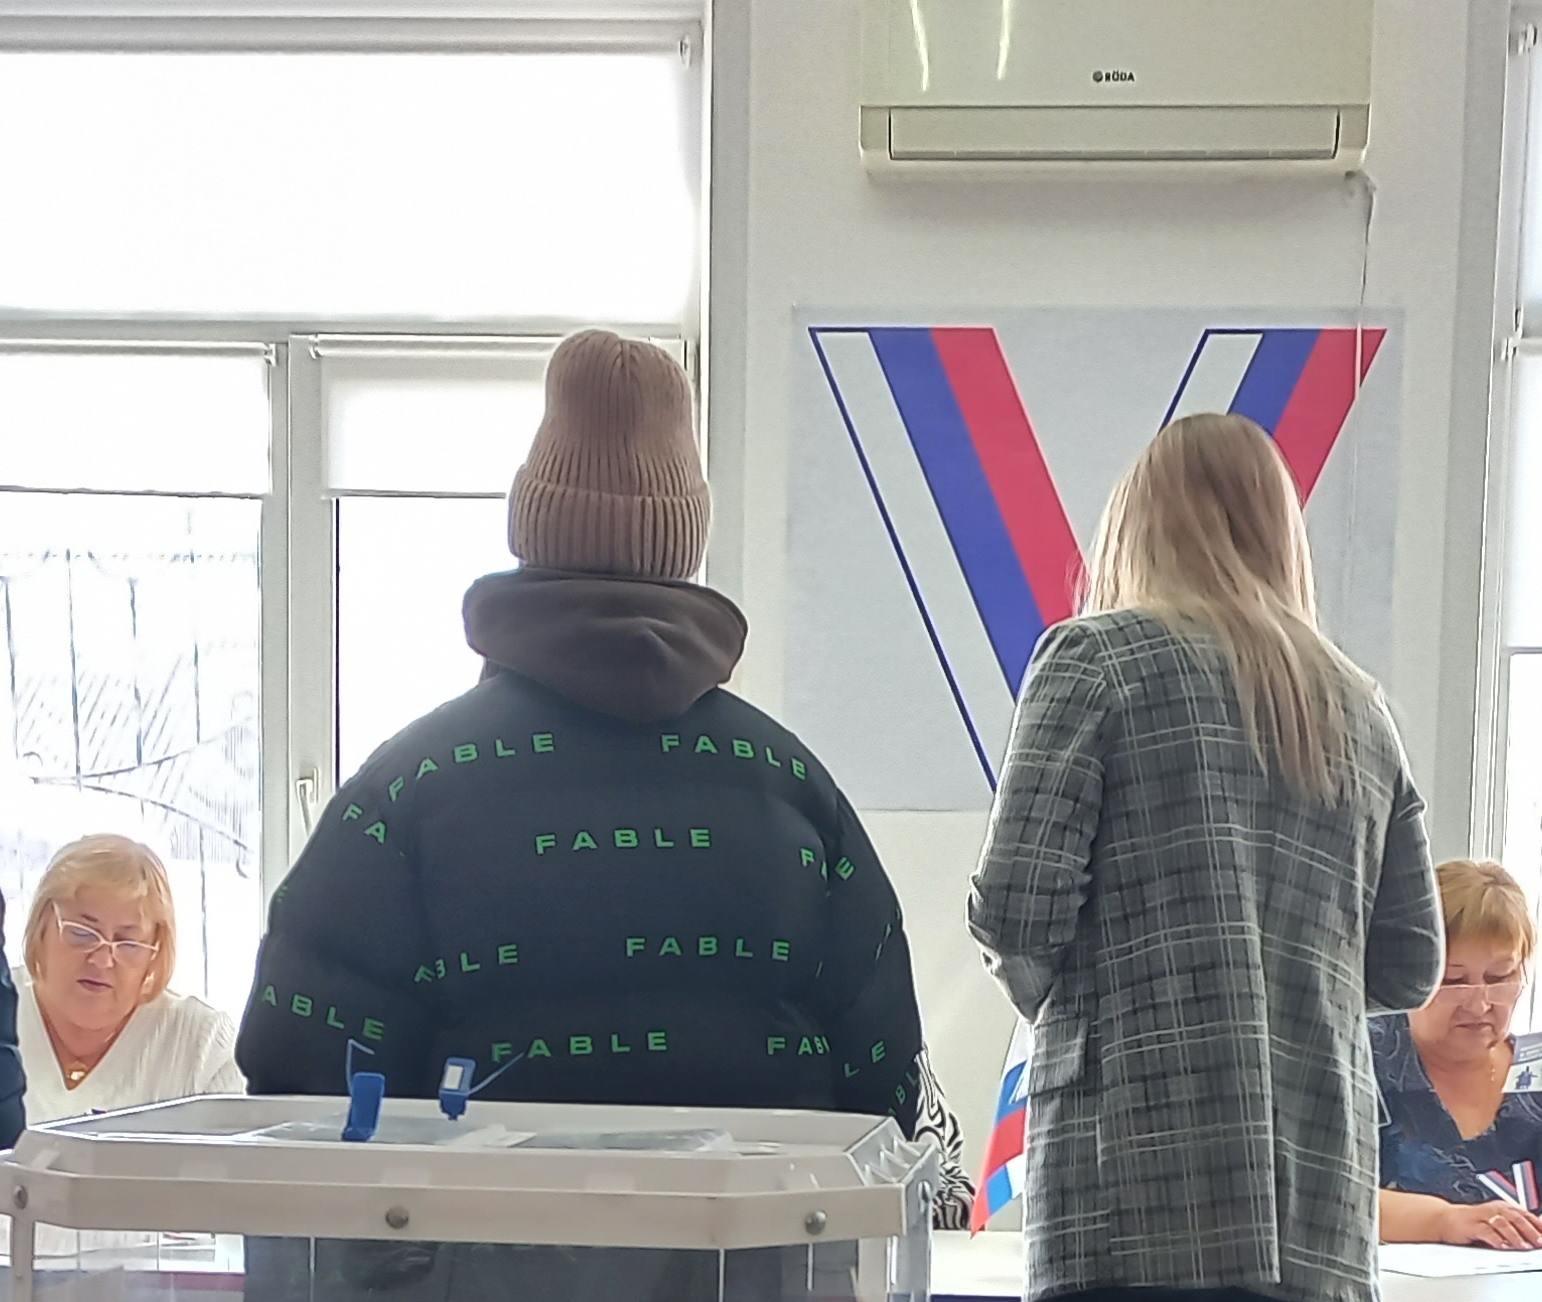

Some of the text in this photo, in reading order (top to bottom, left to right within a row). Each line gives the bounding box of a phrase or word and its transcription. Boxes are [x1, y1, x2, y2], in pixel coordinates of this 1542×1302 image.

[387, 731, 807, 802] FABLE FABLE
[534, 827, 711, 856] FABLE
[625, 936, 790, 962] FABLE
[262, 985, 385, 1041] ABLE
[491, 1031, 668, 1062] FABLE
